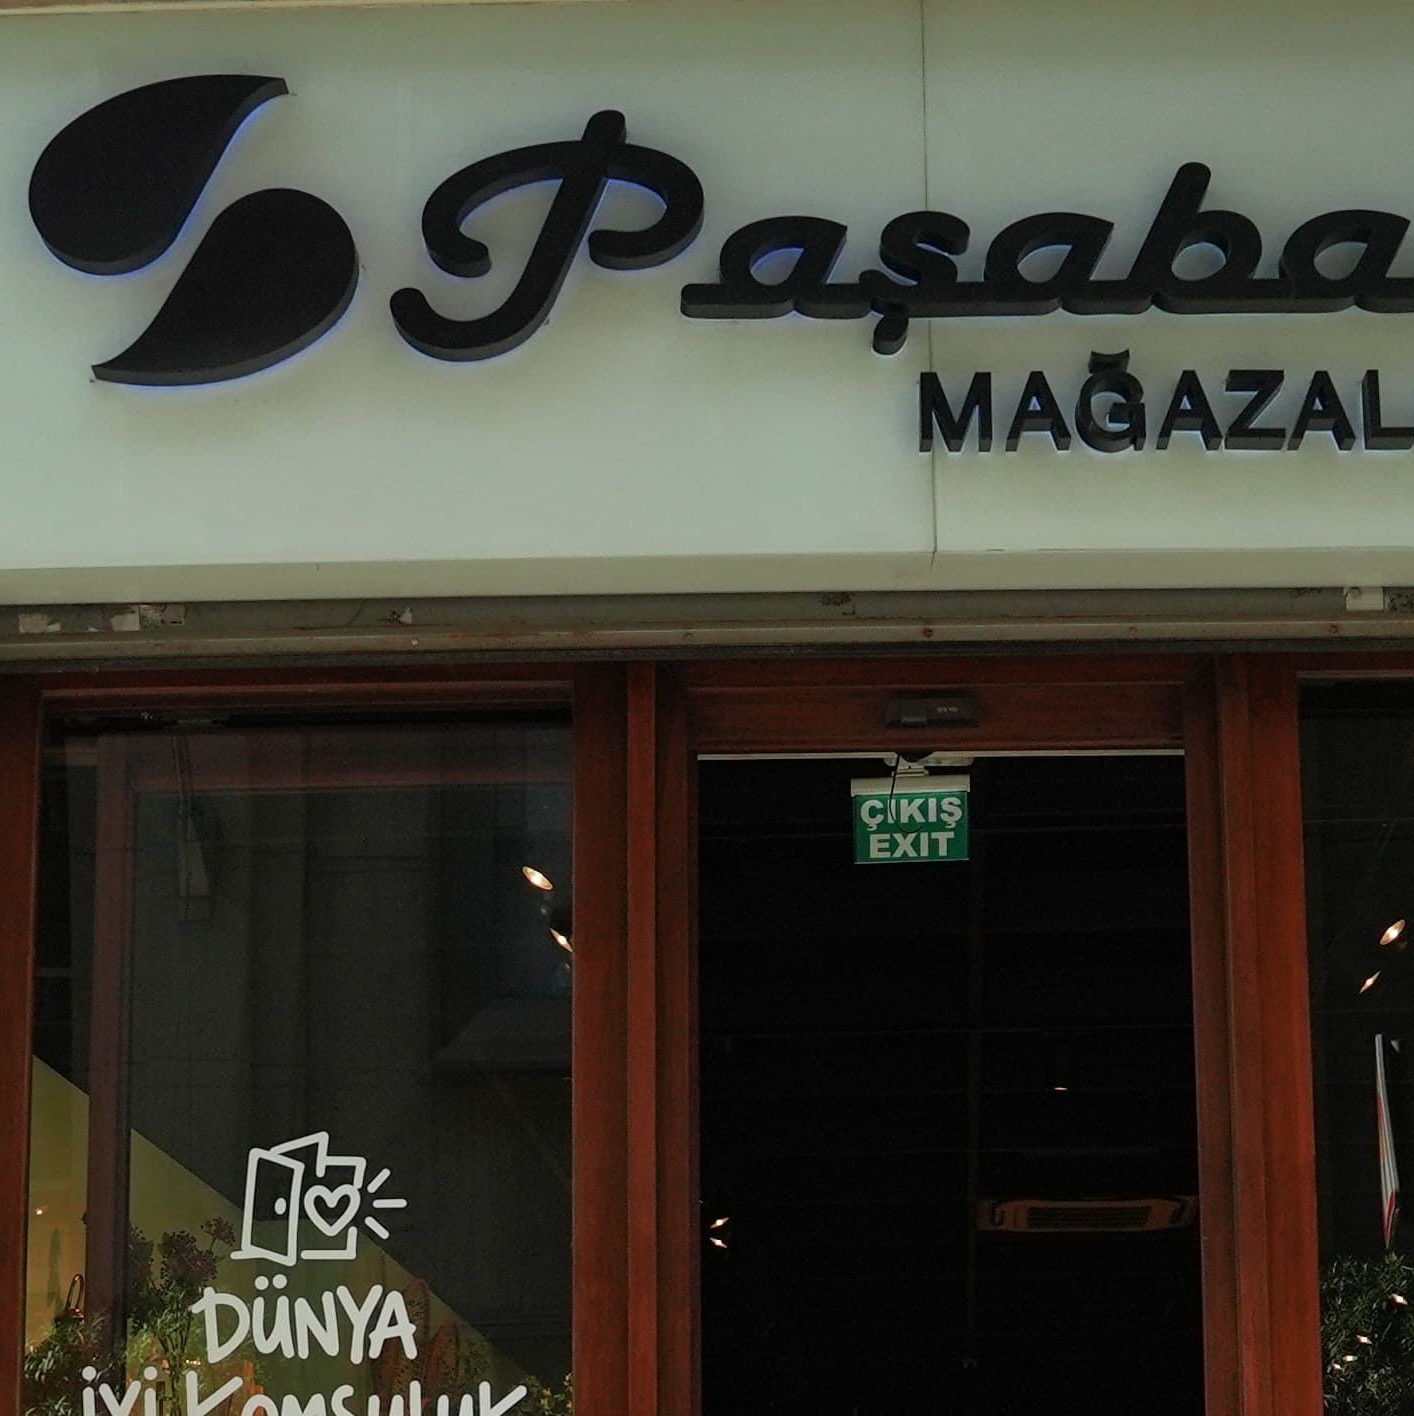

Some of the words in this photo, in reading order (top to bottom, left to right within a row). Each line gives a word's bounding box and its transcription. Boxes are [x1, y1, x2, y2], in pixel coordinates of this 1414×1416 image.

[860, 797, 963, 832] ÇIKIŞ
[869, 831, 955, 859] EXIT
[189, 1274, 418, 1365] DÜNYA
